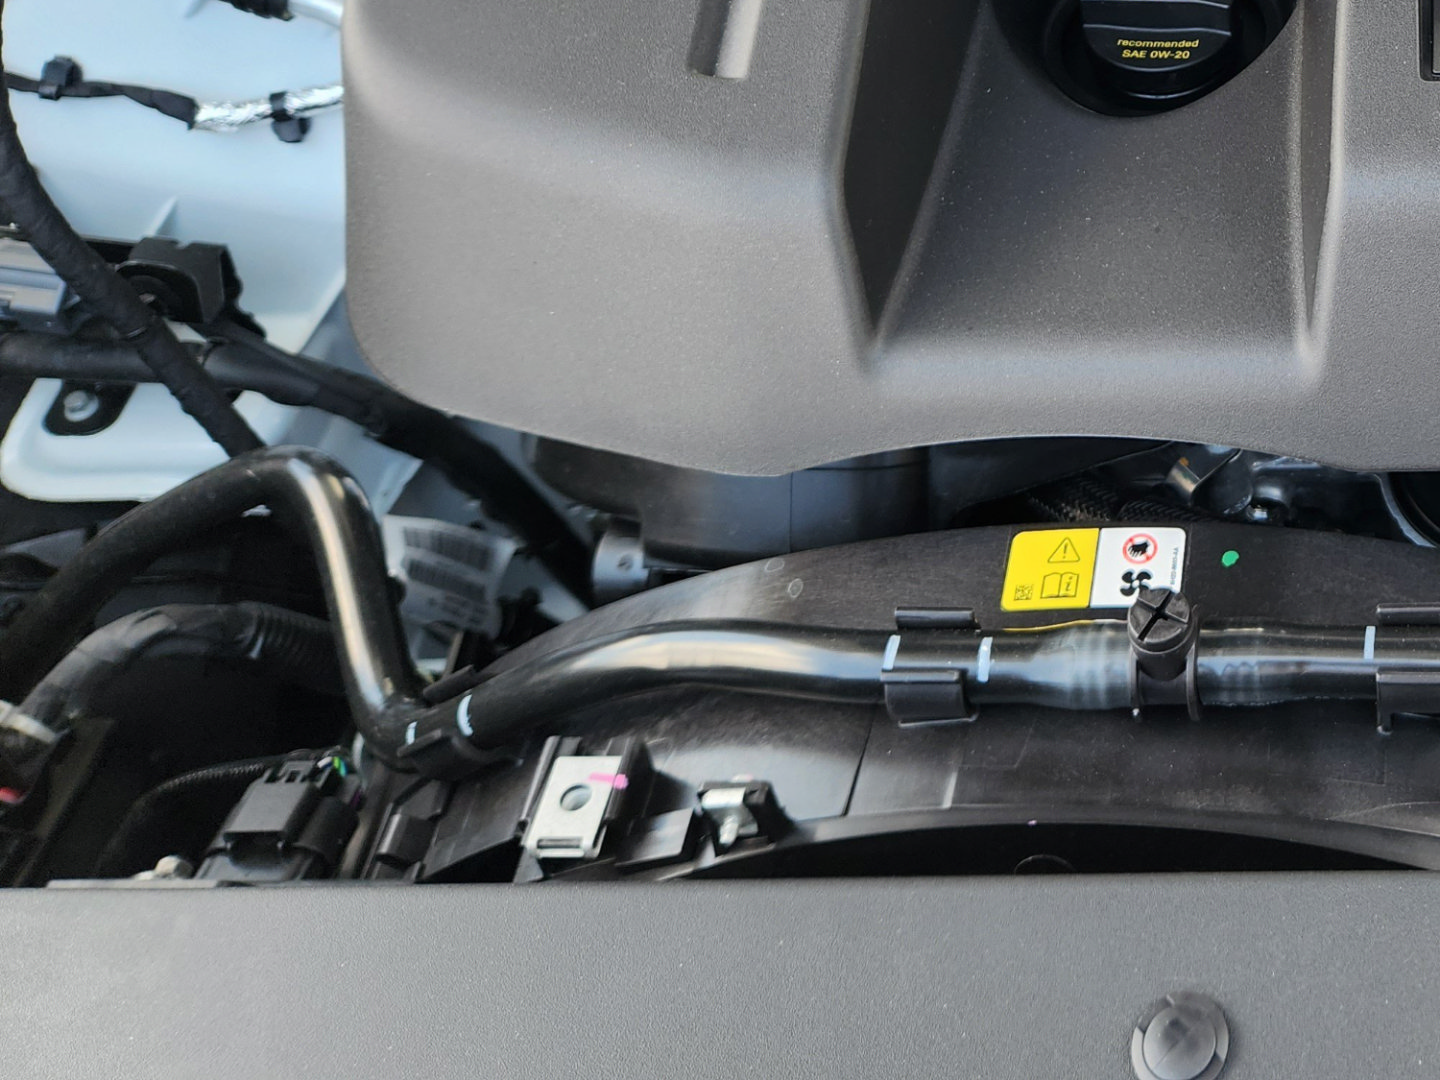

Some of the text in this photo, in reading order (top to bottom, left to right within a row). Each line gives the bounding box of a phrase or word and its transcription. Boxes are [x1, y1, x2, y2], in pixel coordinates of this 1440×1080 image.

[1117, 39, 1199, 48] recommended
[1122, 49, 1190, 59] SAE 0W-20
